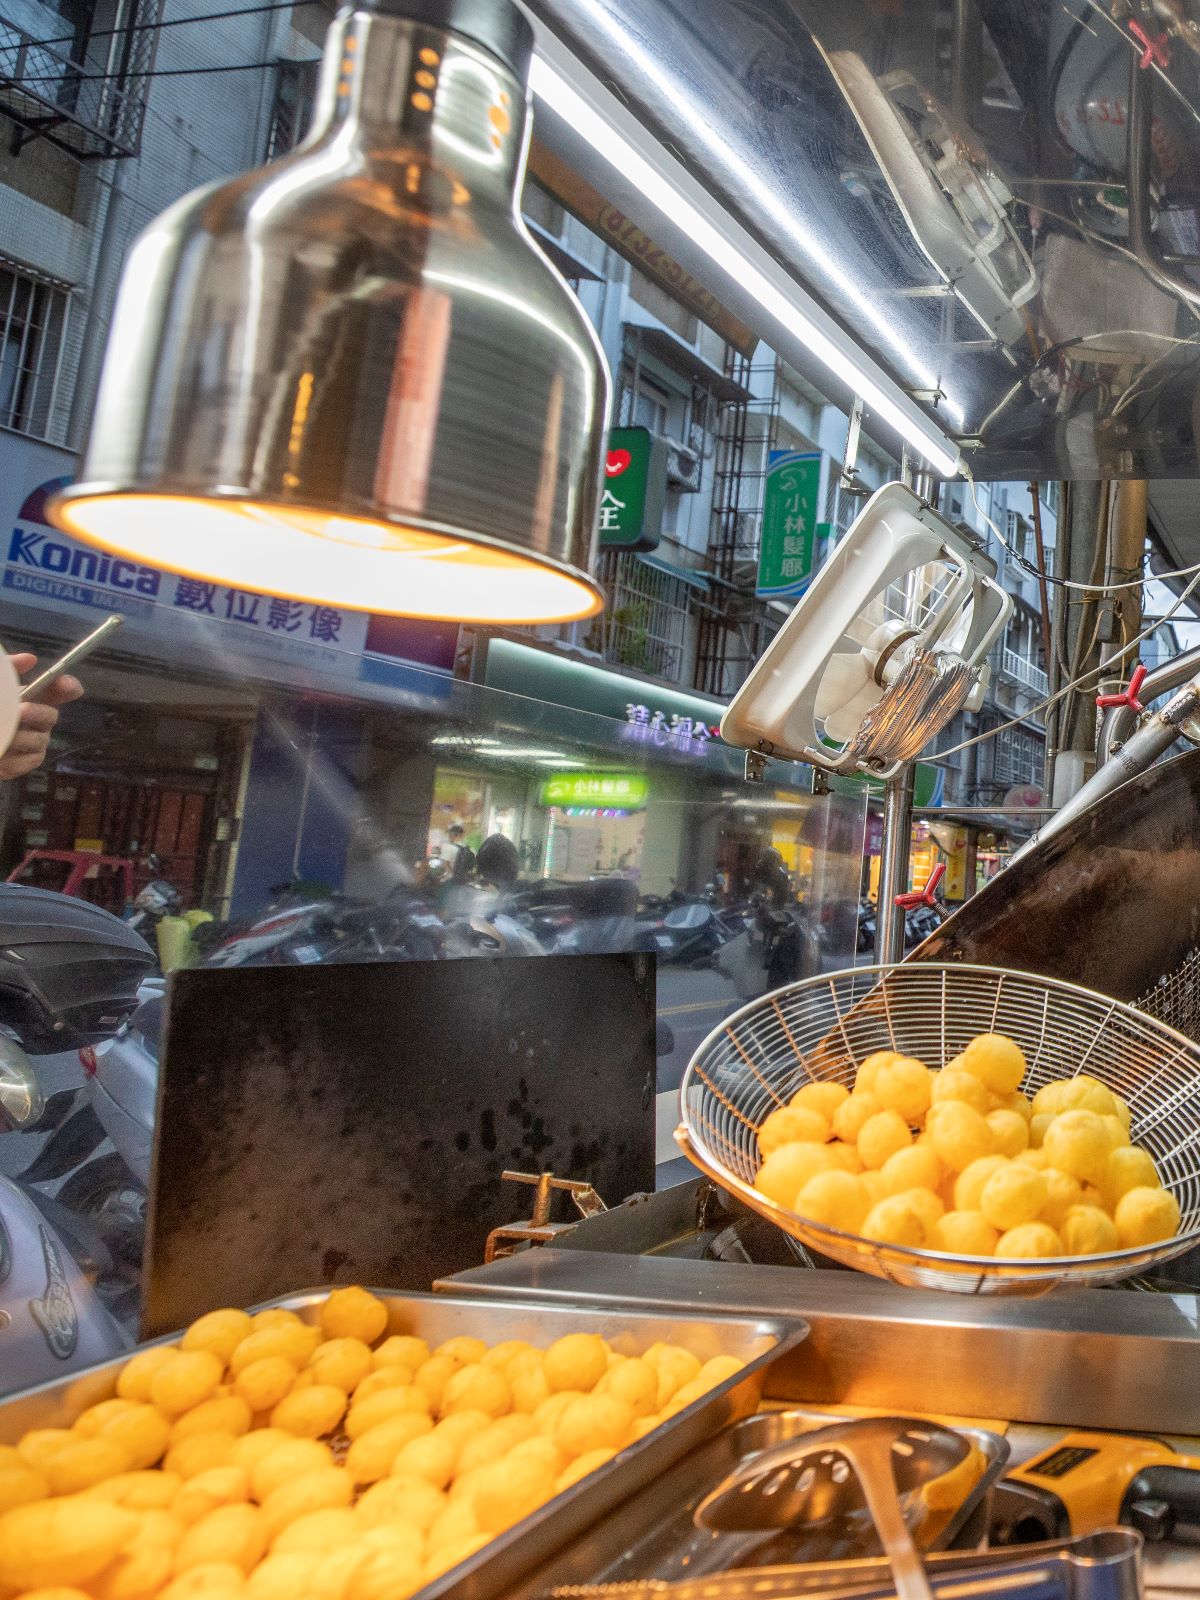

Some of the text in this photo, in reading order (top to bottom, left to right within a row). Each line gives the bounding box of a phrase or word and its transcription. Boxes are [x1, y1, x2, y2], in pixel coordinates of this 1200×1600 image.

[8, 527, 162, 597] Konica
[780, 493, 808, 577] 小林髮廊
[12, 574, 87, 600] DIGITAL
[173, 577, 343, 643] 數位影像
